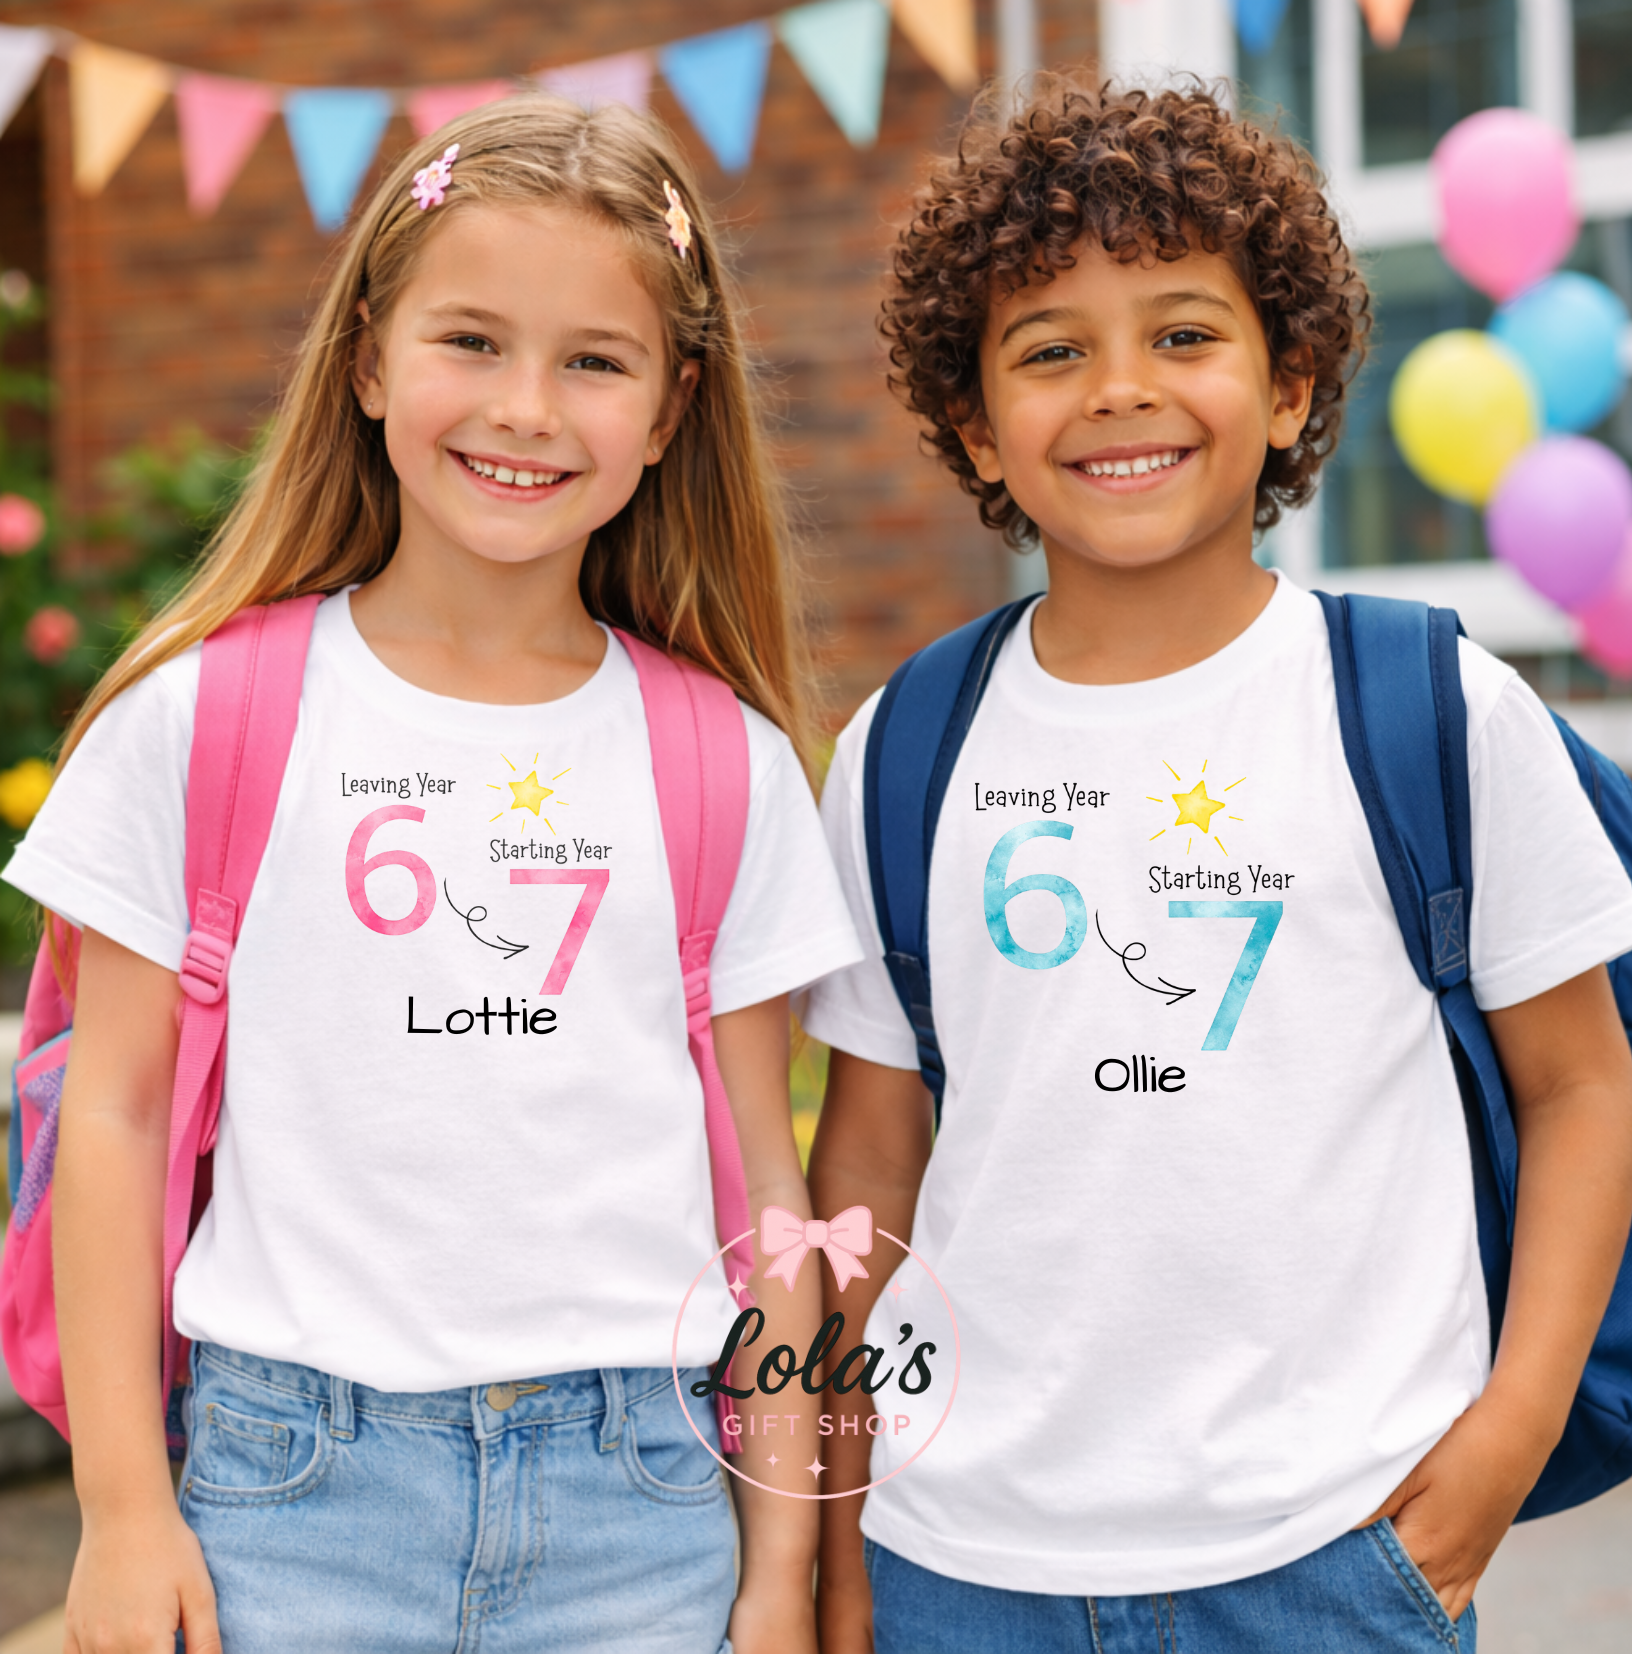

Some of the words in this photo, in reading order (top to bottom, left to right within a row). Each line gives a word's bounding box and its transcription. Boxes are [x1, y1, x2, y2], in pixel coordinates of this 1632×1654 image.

[341, 772, 410, 799] Leaving
[416, 772, 457, 797] Year
[974, 782, 1056, 813] Leaving
[1063, 782, 1111, 811] Year
[345, 804, 437, 936] 6
[489, 838, 568, 864] Starting
[573, 838, 613, 862] Year
[983, 820, 1088, 970] 6
[1148, 864, 1242, 896] Starting
[1248, 864, 1296, 893] Year
[509, 868, 610, 996] 7
[1168, 900, 1284, 1051] 7
[407, 996, 558, 1036] Lottie
[1094, 1054, 1187, 1093] Ollie
